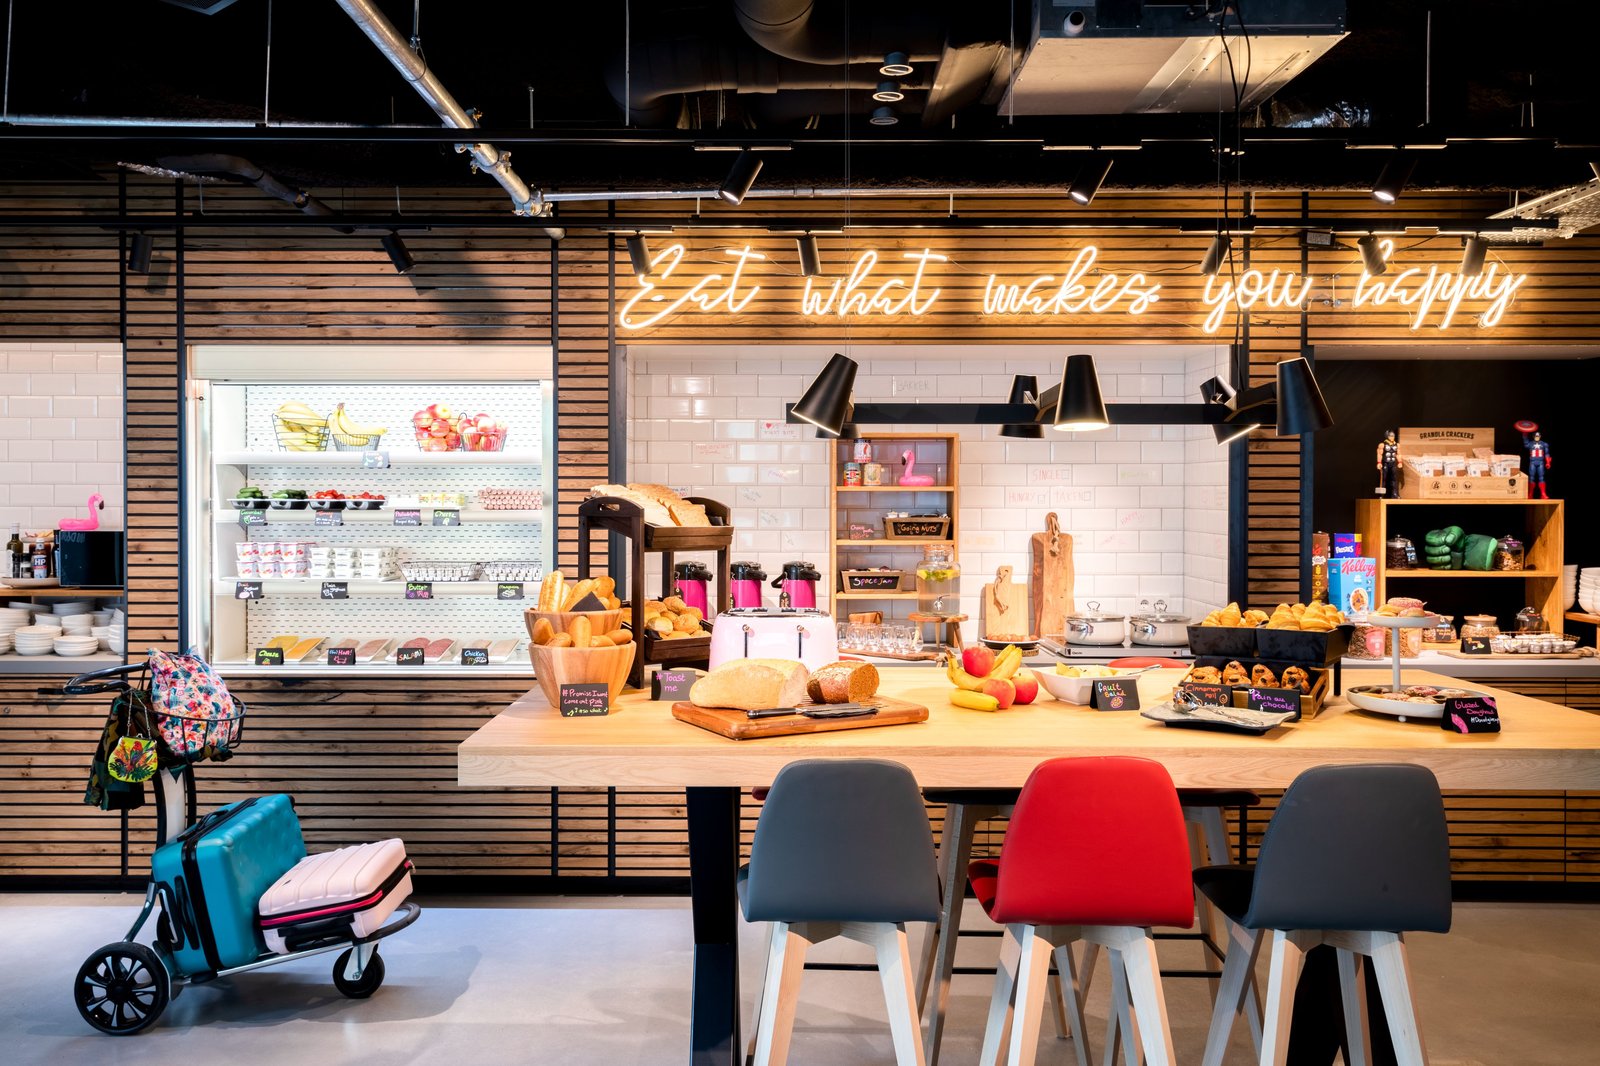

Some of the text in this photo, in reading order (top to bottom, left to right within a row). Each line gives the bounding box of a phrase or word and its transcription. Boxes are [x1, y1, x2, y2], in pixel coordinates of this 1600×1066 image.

[620, 239, 1527, 334] Eat what makes you happy
[1420, 431, 1475, 440] GRANOLA CRACKERS
[900, 524, 919, 534] Going
[34, 558, 46, 566] HP
[853, 577, 878, 587] Space
[1186, 684, 1222, 693] Cinnamon
[1251, 691, 1272, 702] Pain
